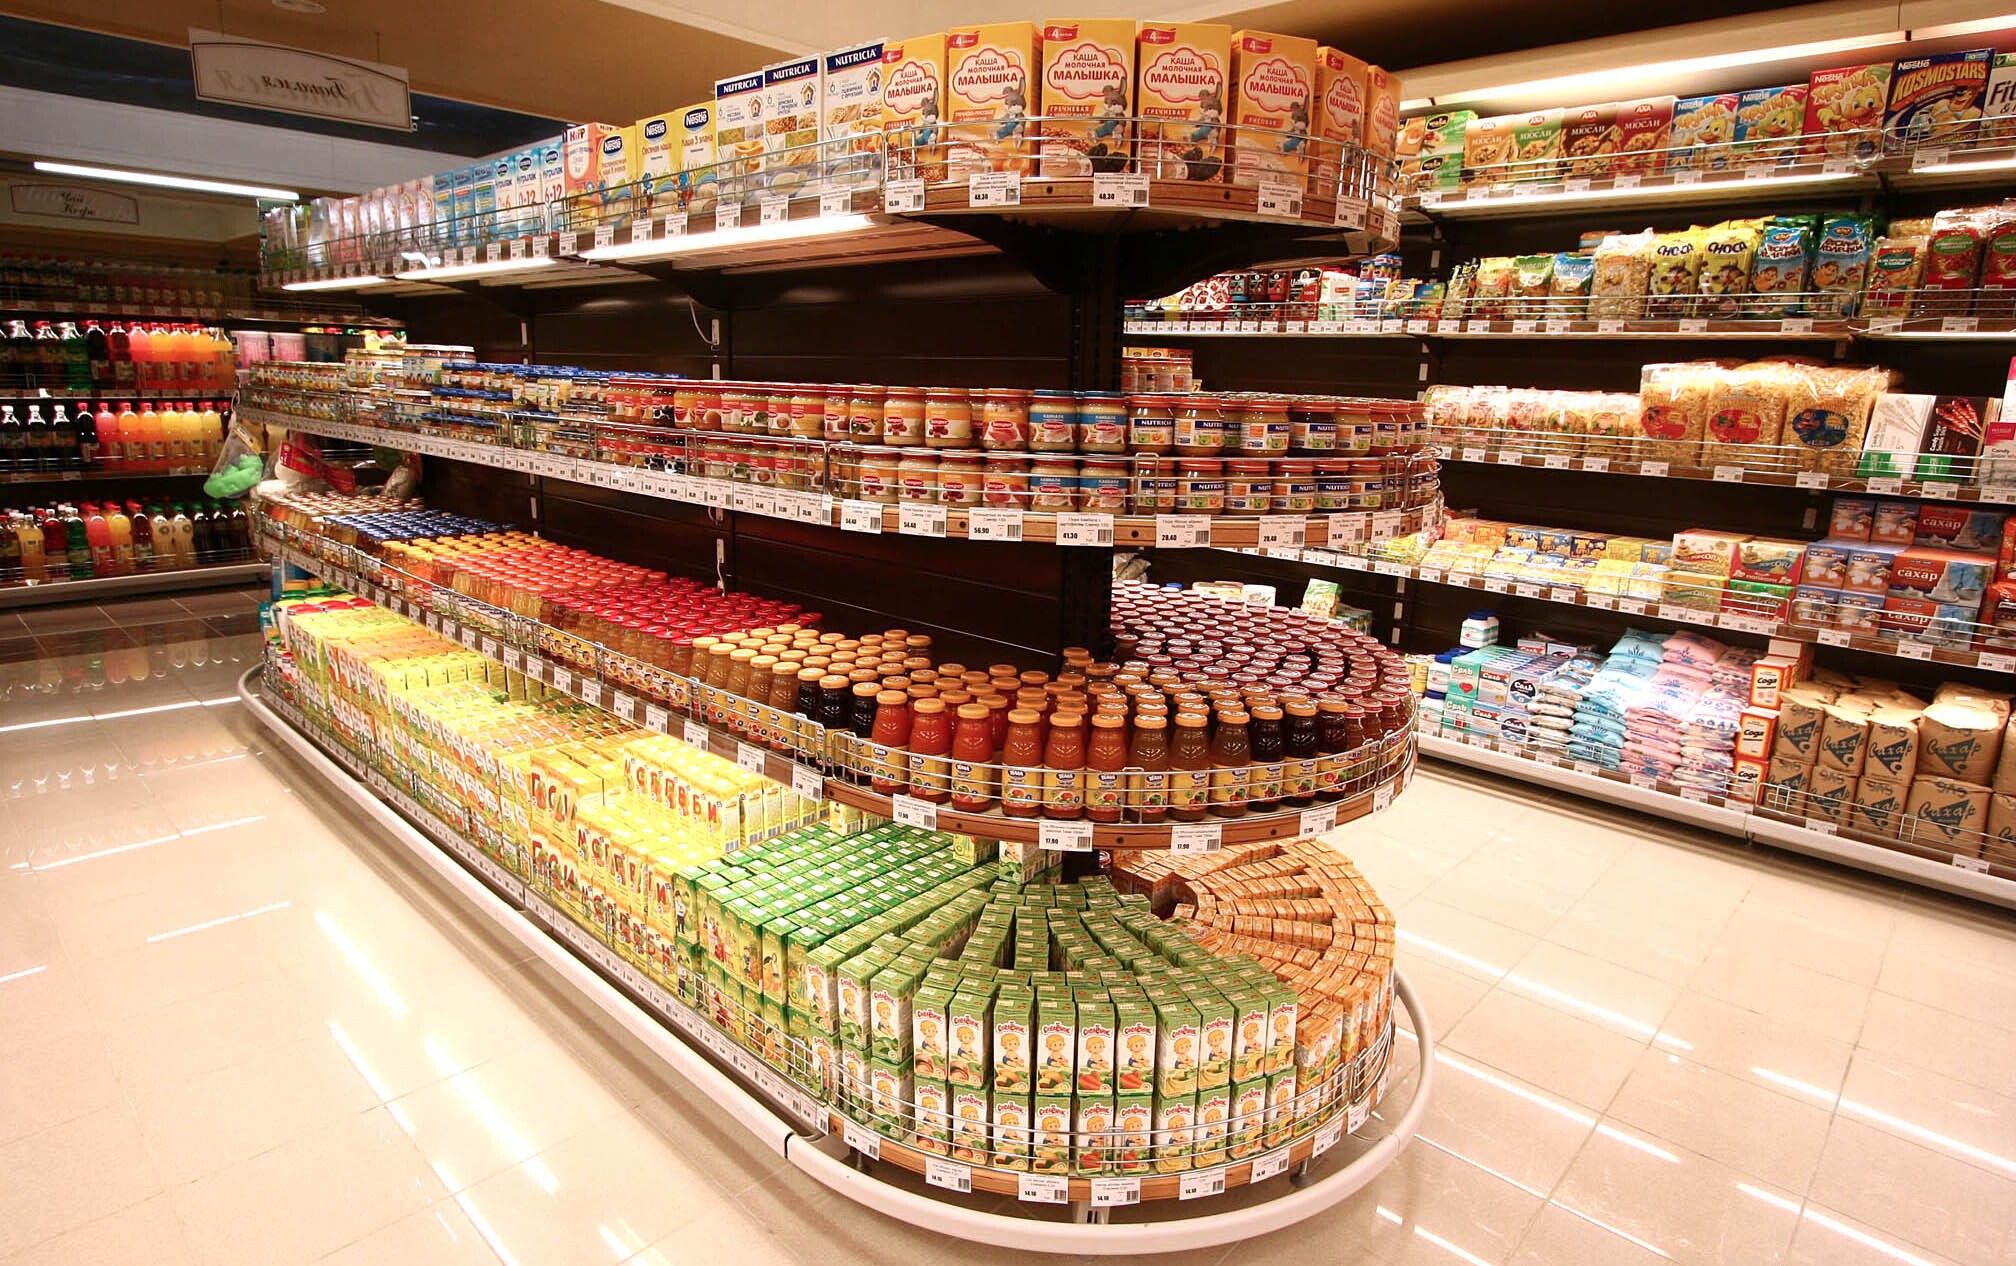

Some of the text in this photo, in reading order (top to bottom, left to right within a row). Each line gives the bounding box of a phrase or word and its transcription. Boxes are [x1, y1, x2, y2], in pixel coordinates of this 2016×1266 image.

[835, 49, 876, 66] NUTRICIA
[975, 58, 998, 66] КАША
[1073, 53, 1098, 61] КАША
[1898, 59, 1930, 70] Nestlé
[773, 65, 811, 79] NUTRICIA
[901, 70, 917, 78] КАША
[1053, 70, 1119, 80] МАЛЫШКА
[1267, 68, 1287, 77] КАША
[958, 73, 1017, 86] МАЛЫШКА
[1151, 74, 1215, 85] МАЛЫШКА
[1260, 76, 1293, 84] МОЛОЧНАЯ
[1815, 73, 1843, 83] Nestlé
[724, 80, 758, 93] NUTRICIA
[1893, 64, 1986, 104] KOSMOSTARS
[888, 84, 932, 98] МАЛЫШКА
[1250, 82, 1303, 98] МАЛЫШКА
[1624, 120, 1660, 129] МЮСЛИ
[1571, 126, 1605, 136] МЮСЛИ
[1923, 517, 1961, 530] сахар
[1897, 569, 1938, 582] сахар
[1452, 664, 1473, 675] Соль
[1483, 672, 1501, 681] Соль
[1514, 682, 1533, 691] Соль
[1446, 701, 1467, 712] Соль
[1474, 709, 1493, 719] Соль
[1823, 735, 1865, 751] Сахар
[1926, 738, 1982, 755] Сахар
[1869, 742, 1912, 757] Сахар
[1919, 801, 1977, 820] Сахар
